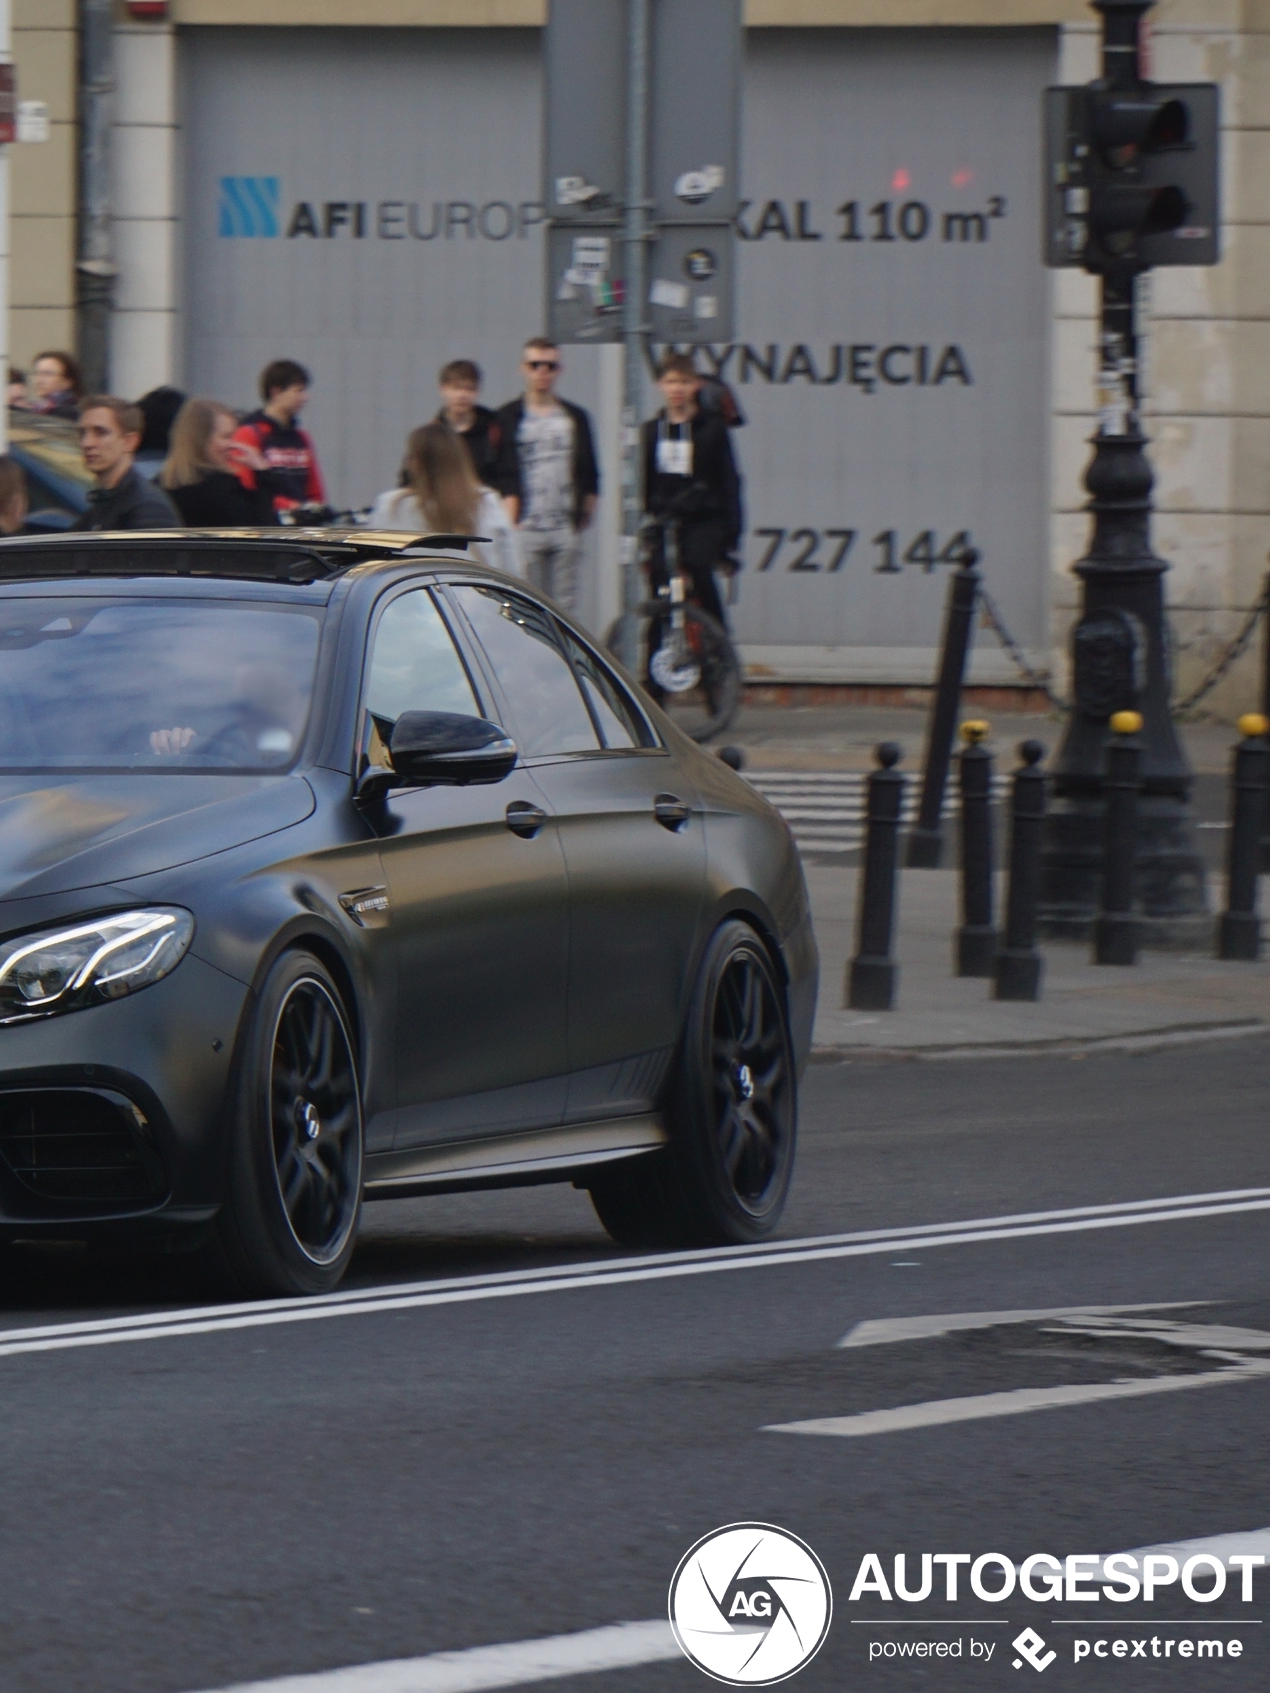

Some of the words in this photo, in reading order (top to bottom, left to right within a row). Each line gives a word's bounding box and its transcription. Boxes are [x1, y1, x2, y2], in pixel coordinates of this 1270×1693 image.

[287, 202, 366, 239] AFI
[377, 200, 545, 241] EUROP
[736, 200, 821, 241] KAL
[837, 200, 931, 242] 110
[753, 527, 858, 573] 727
